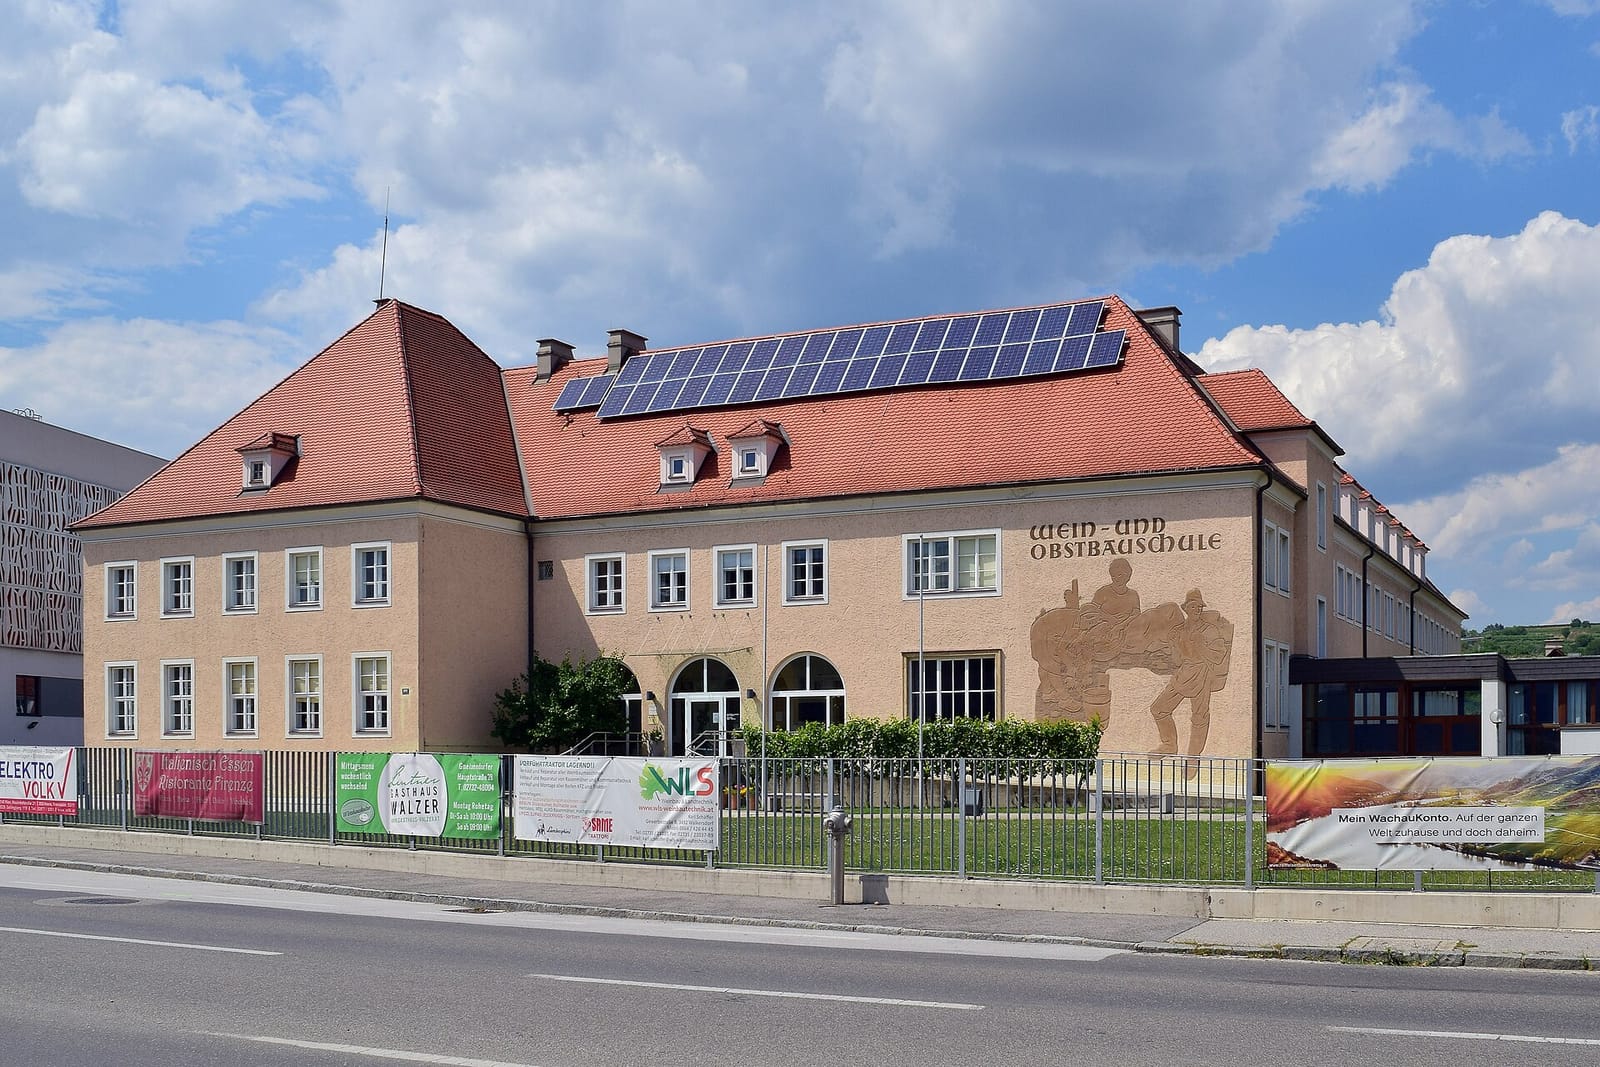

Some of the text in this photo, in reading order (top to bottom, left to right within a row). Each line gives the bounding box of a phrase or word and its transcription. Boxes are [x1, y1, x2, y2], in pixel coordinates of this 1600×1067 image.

[0, 761, 54, 779] ELEKTRO
[161, 754, 254, 773] Italienisch Essen
[23, 780, 55, 799] VOLK
[159, 775, 254, 792] Ristorante Firenze
[648, 767, 714, 796] WLS
[391, 799, 439, 816] WALZER
[484, 813, 493, 821] Uhr
[591, 817, 613, 833] SAME
[1338, 813, 1538, 824] Mein WachauKonto. Auf der ganzen
[483, 824, 493, 832] Uhr
[1369, 828, 1540, 837] Welt zuhause und doch daheim.
